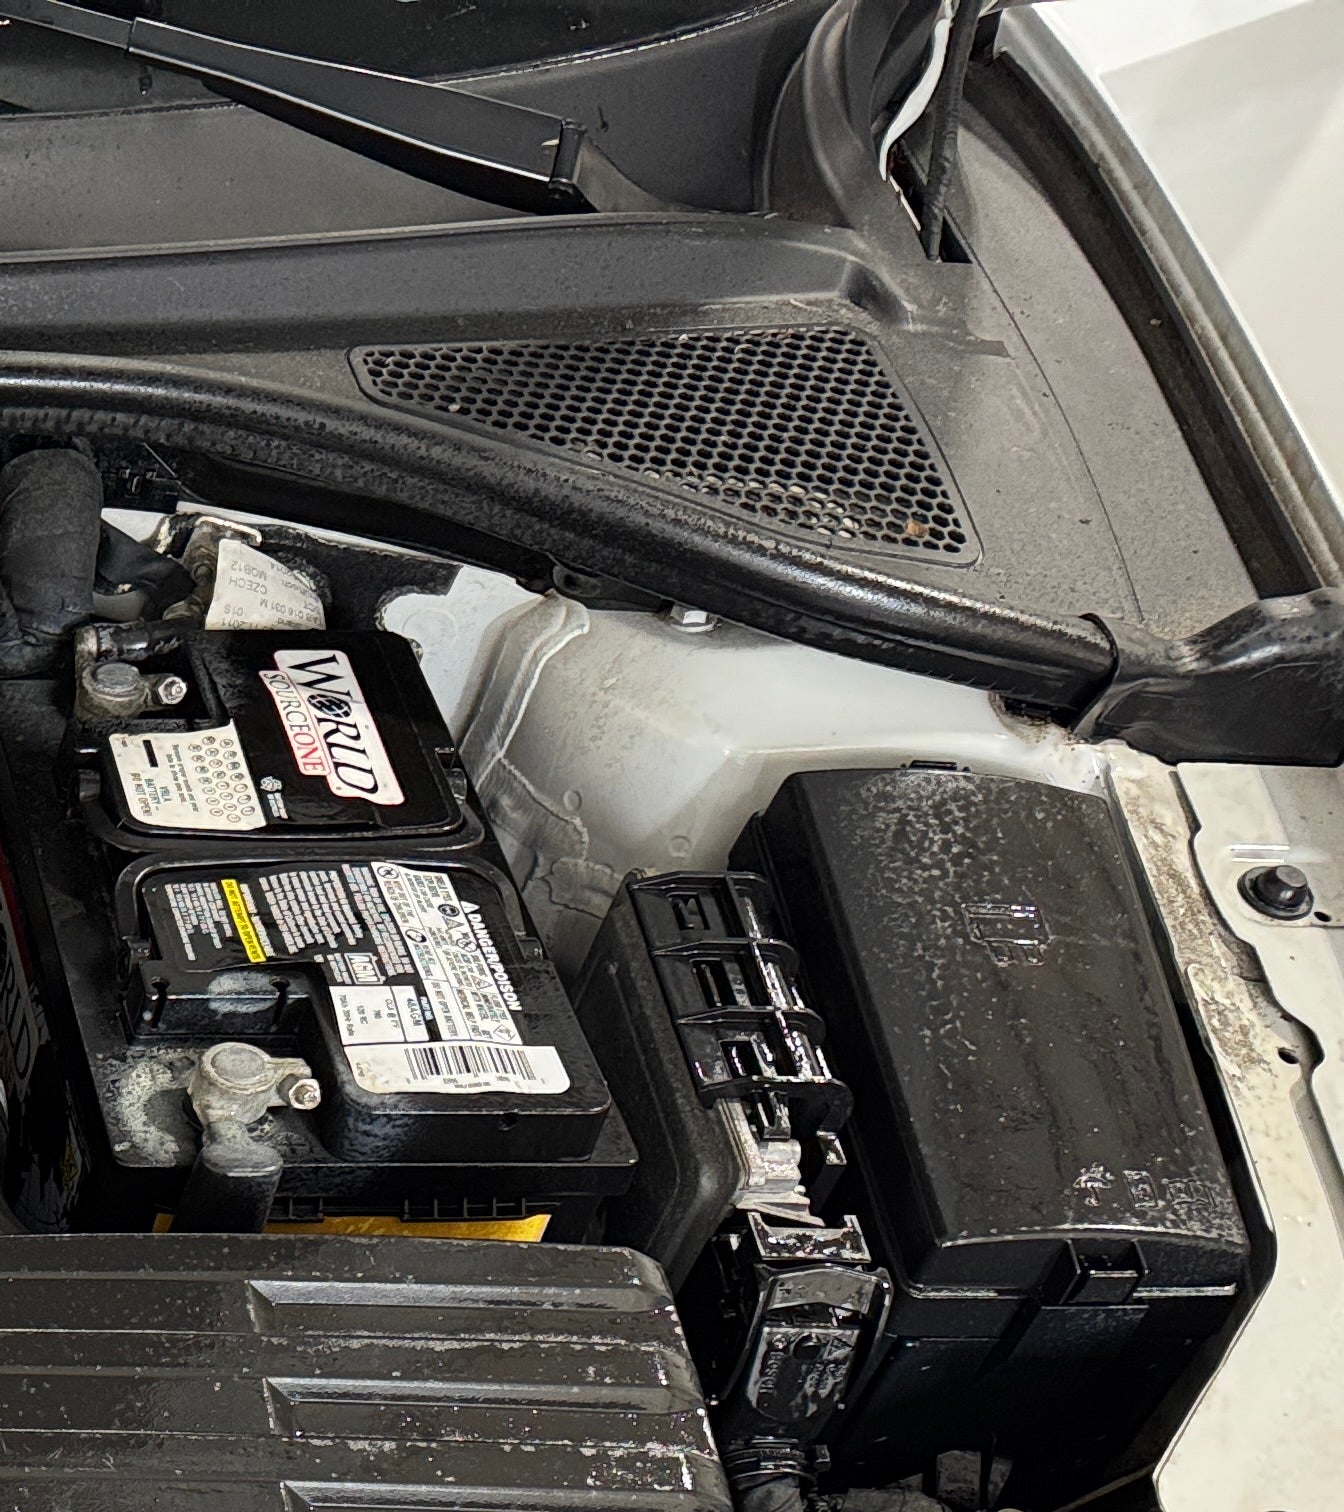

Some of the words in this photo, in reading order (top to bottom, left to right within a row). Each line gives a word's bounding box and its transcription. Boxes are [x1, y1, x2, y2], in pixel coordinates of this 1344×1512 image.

[229, 576, 268, 595] CZECH
[265, 673, 326, 772] SOURCEONE
[287, 653, 378, 794] WORLD
[350, 955, 374, 982] AGM
[468, 913, 522, 1011] DANGER/POISON
